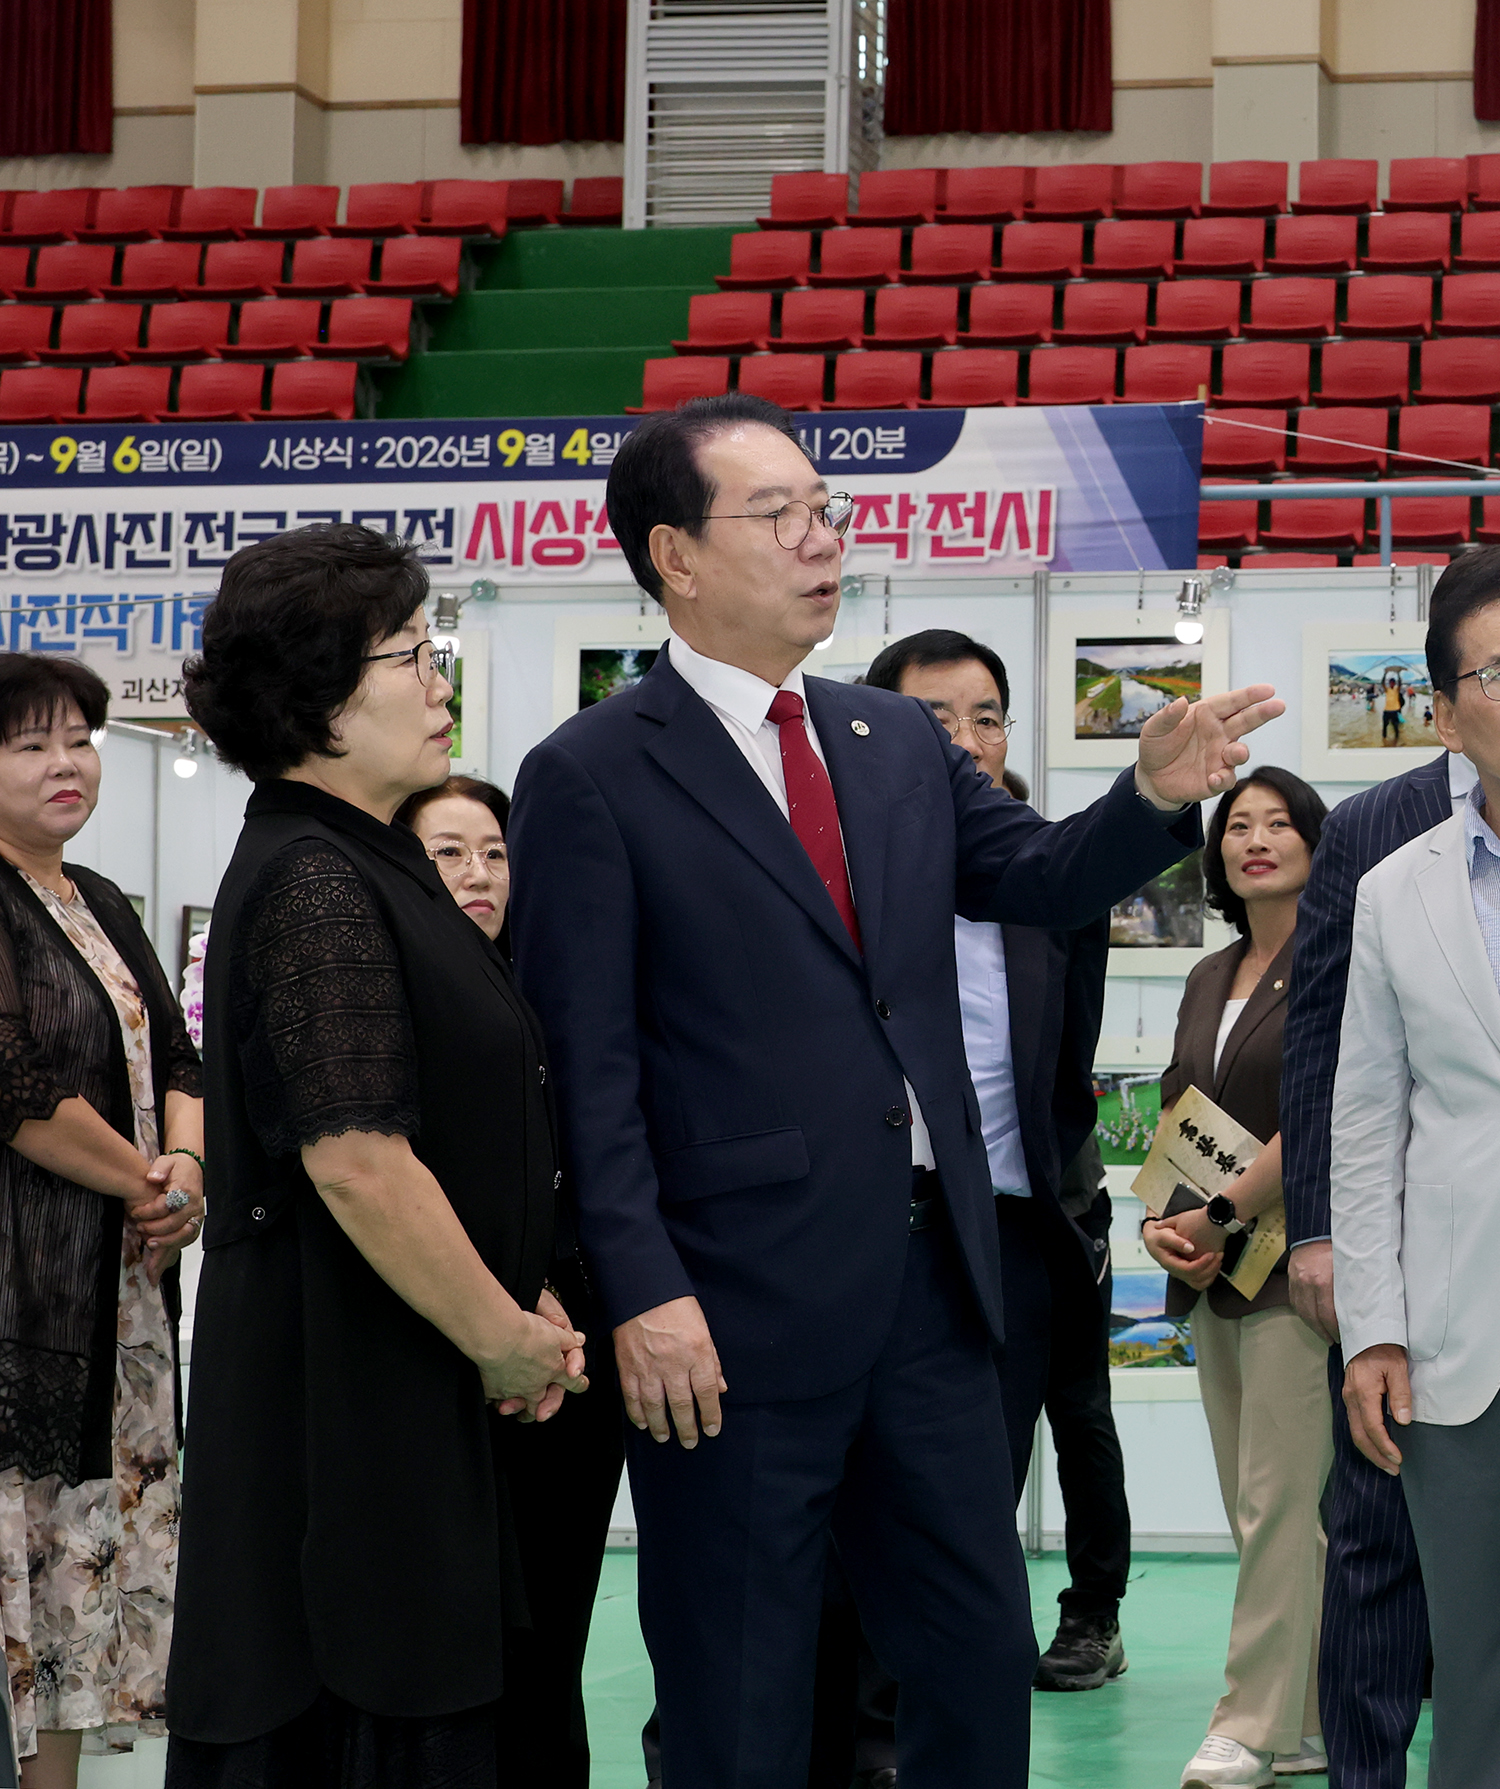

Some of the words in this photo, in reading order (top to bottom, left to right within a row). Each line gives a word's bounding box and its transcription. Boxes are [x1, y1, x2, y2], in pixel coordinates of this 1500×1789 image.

[50, 436, 106, 475] 9월
[112, 435, 222, 475] 6일(일)
[259, 437, 354, 471] 시상식
[374, 435, 490, 469] 2026년
[497, 428, 555, 468] 9월
[828, 425, 906, 461] 20분
